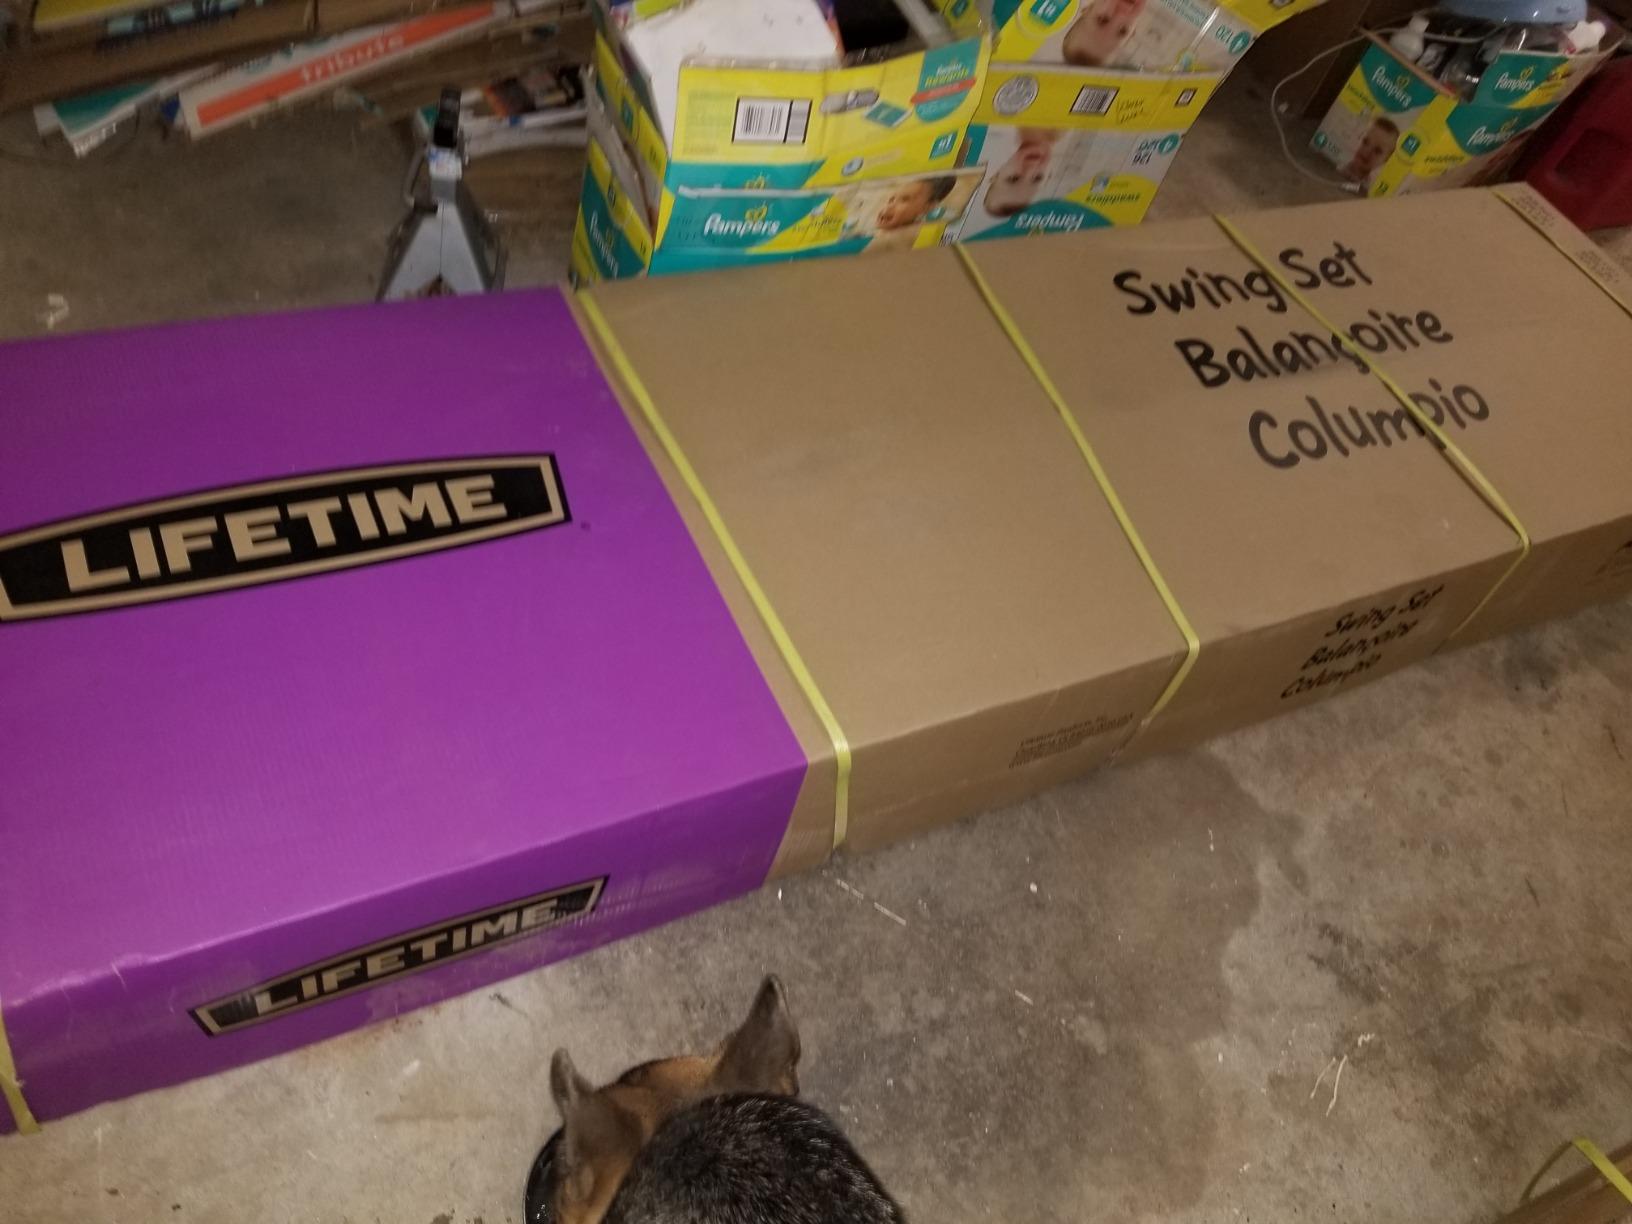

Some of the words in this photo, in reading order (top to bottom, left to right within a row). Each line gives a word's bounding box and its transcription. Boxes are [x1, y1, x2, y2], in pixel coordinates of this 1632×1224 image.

[1372, 65, 1412, 108] Pampers
[1494, 71, 1535, 92] Pampers
[703, 212, 781, 239] Pampers
[1014, 210, 1085, 233] Pampers
[1113, 266, 1288, 316] Swing
[1279, 241, 1373, 290] Set
[60, 473, 508, 593] LIFETIME
[253, 897, 559, 1017] LIFETIME
